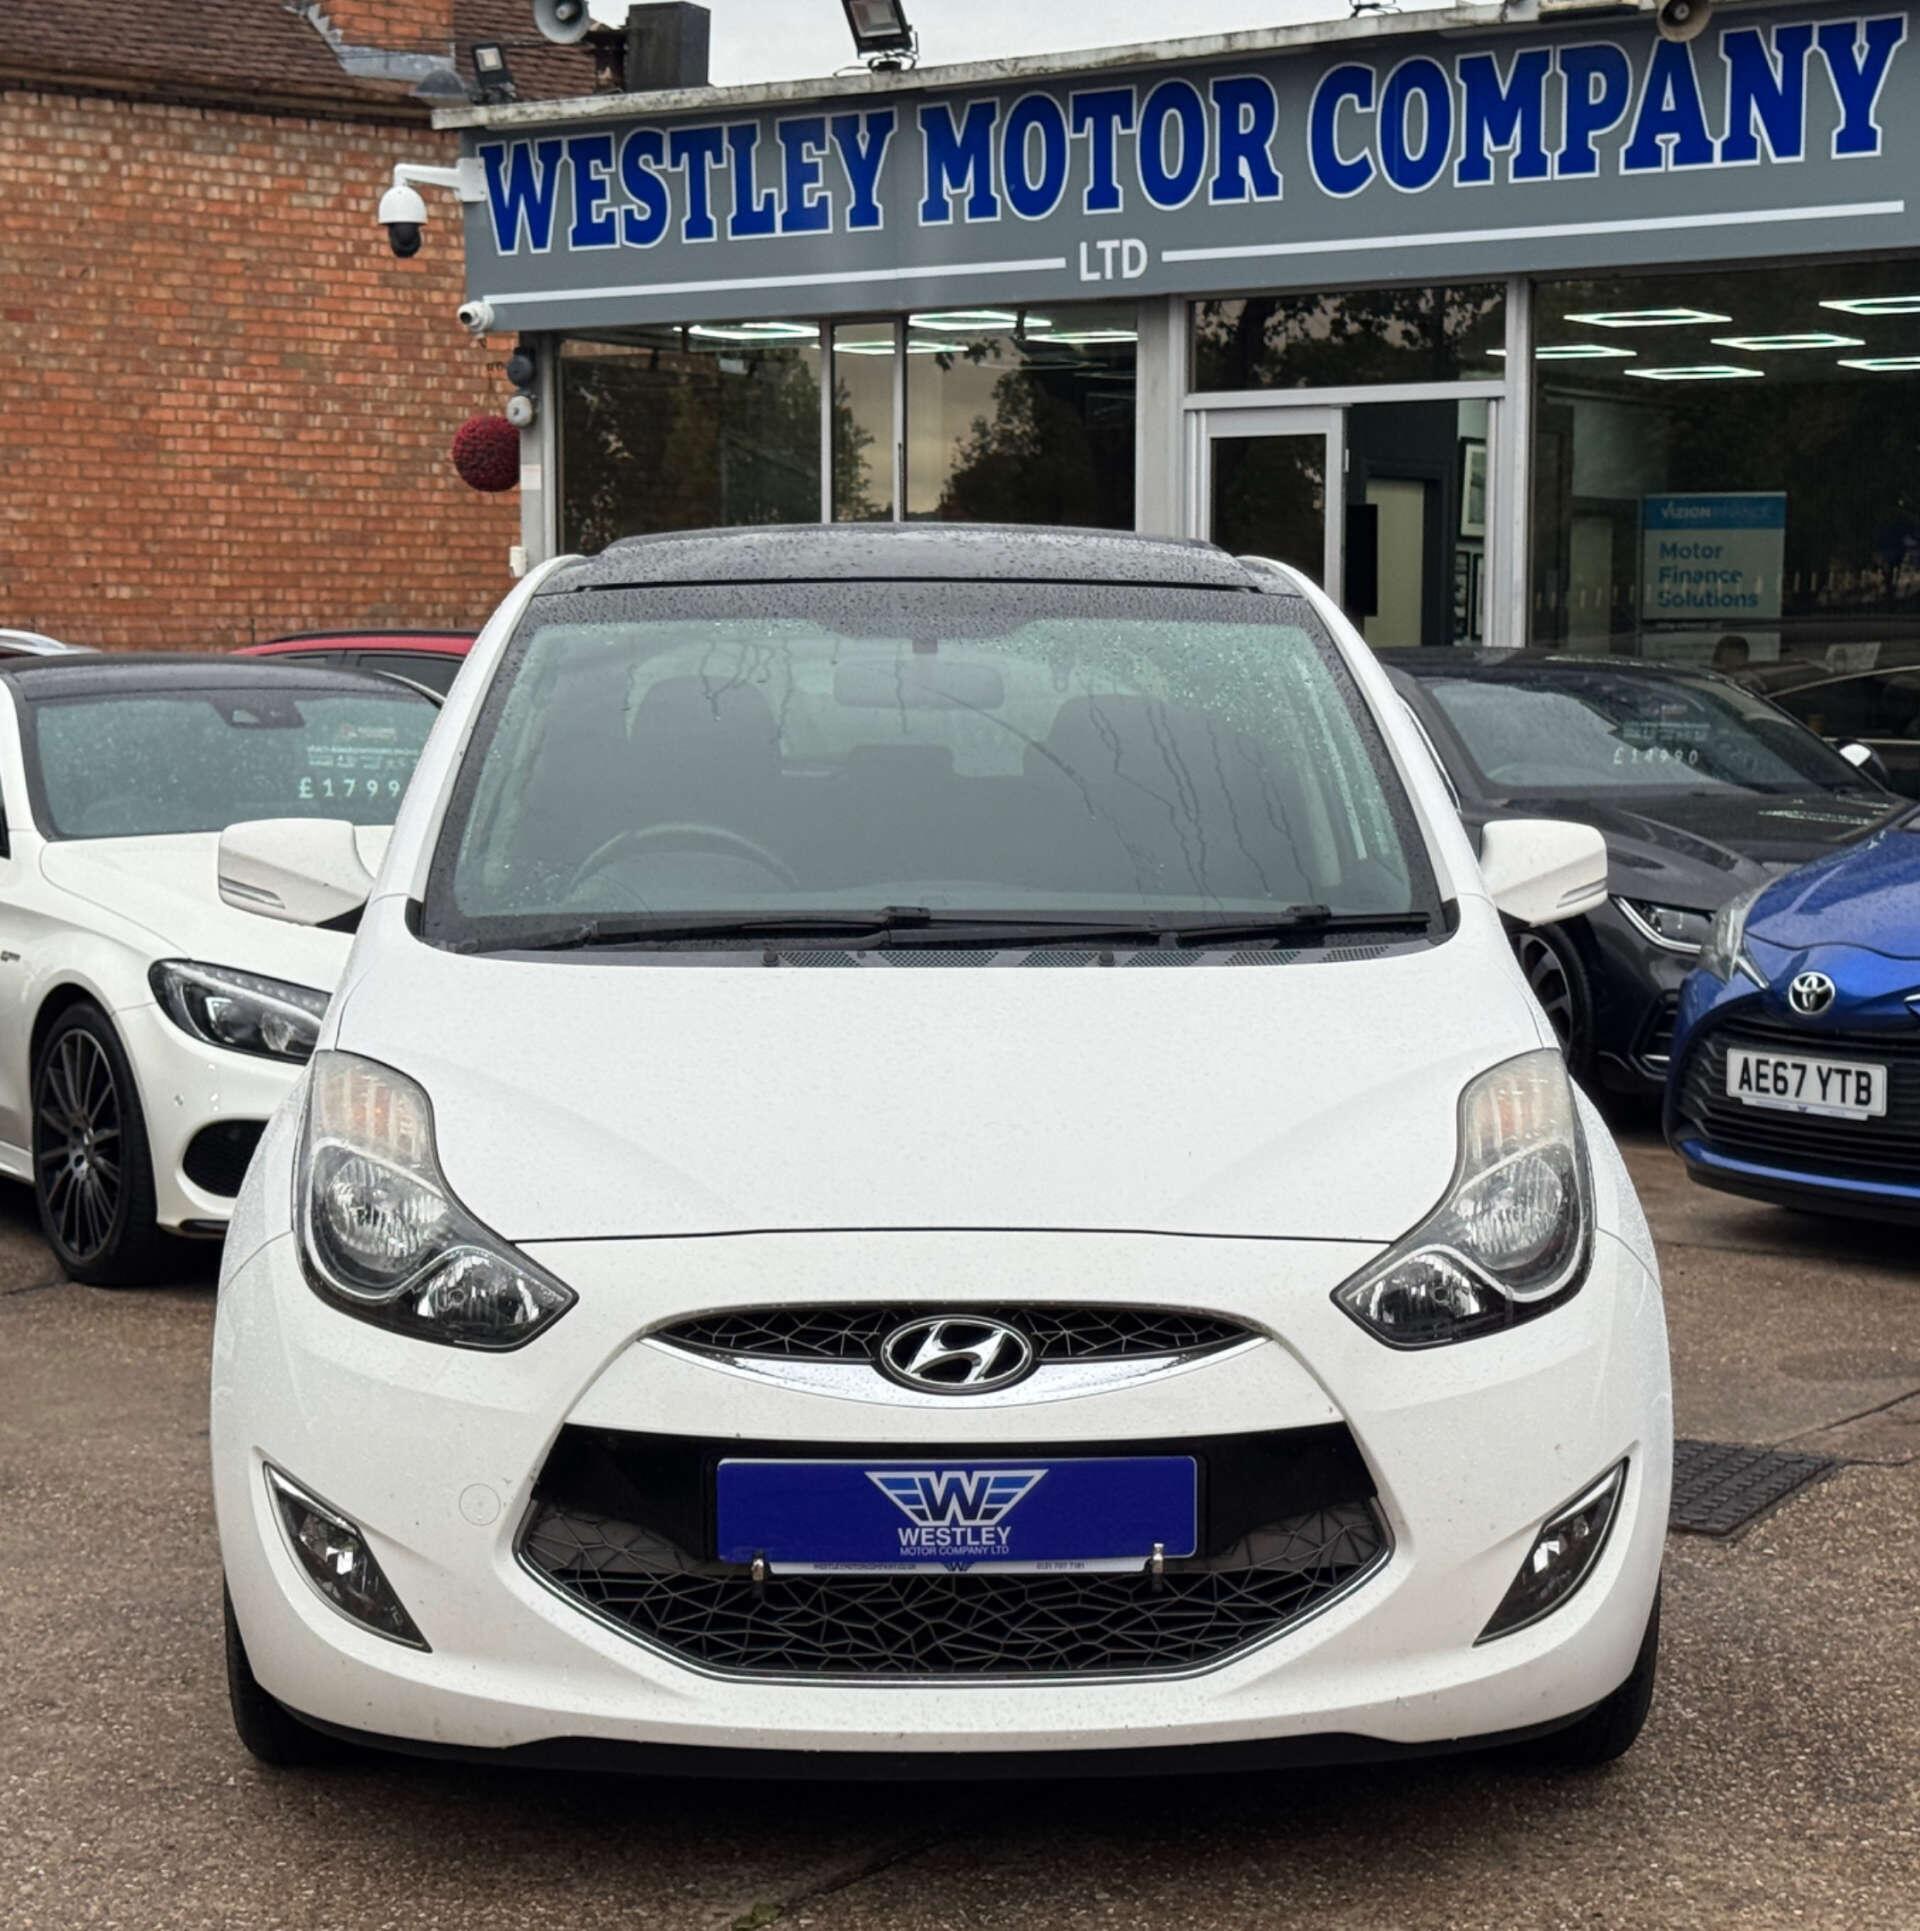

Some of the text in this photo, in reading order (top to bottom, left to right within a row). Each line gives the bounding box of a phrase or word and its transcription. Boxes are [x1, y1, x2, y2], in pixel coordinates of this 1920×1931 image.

[477, 13, 1908, 256] WESTLEY MOTOR COMPANY
[1078, 238, 1149, 282] LTD
[1658, 542, 1723, 559] Motor
[1658, 565, 1744, 584] Finance
[1657, 589, 1760, 609] Solutions
[1738, 1056, 1872, 1107] AE67 YTB
[897, 1526, 1012, 1546] WESTLEY
[899, 1545, 1009, 1557] MOTOR COMPANY LTD
